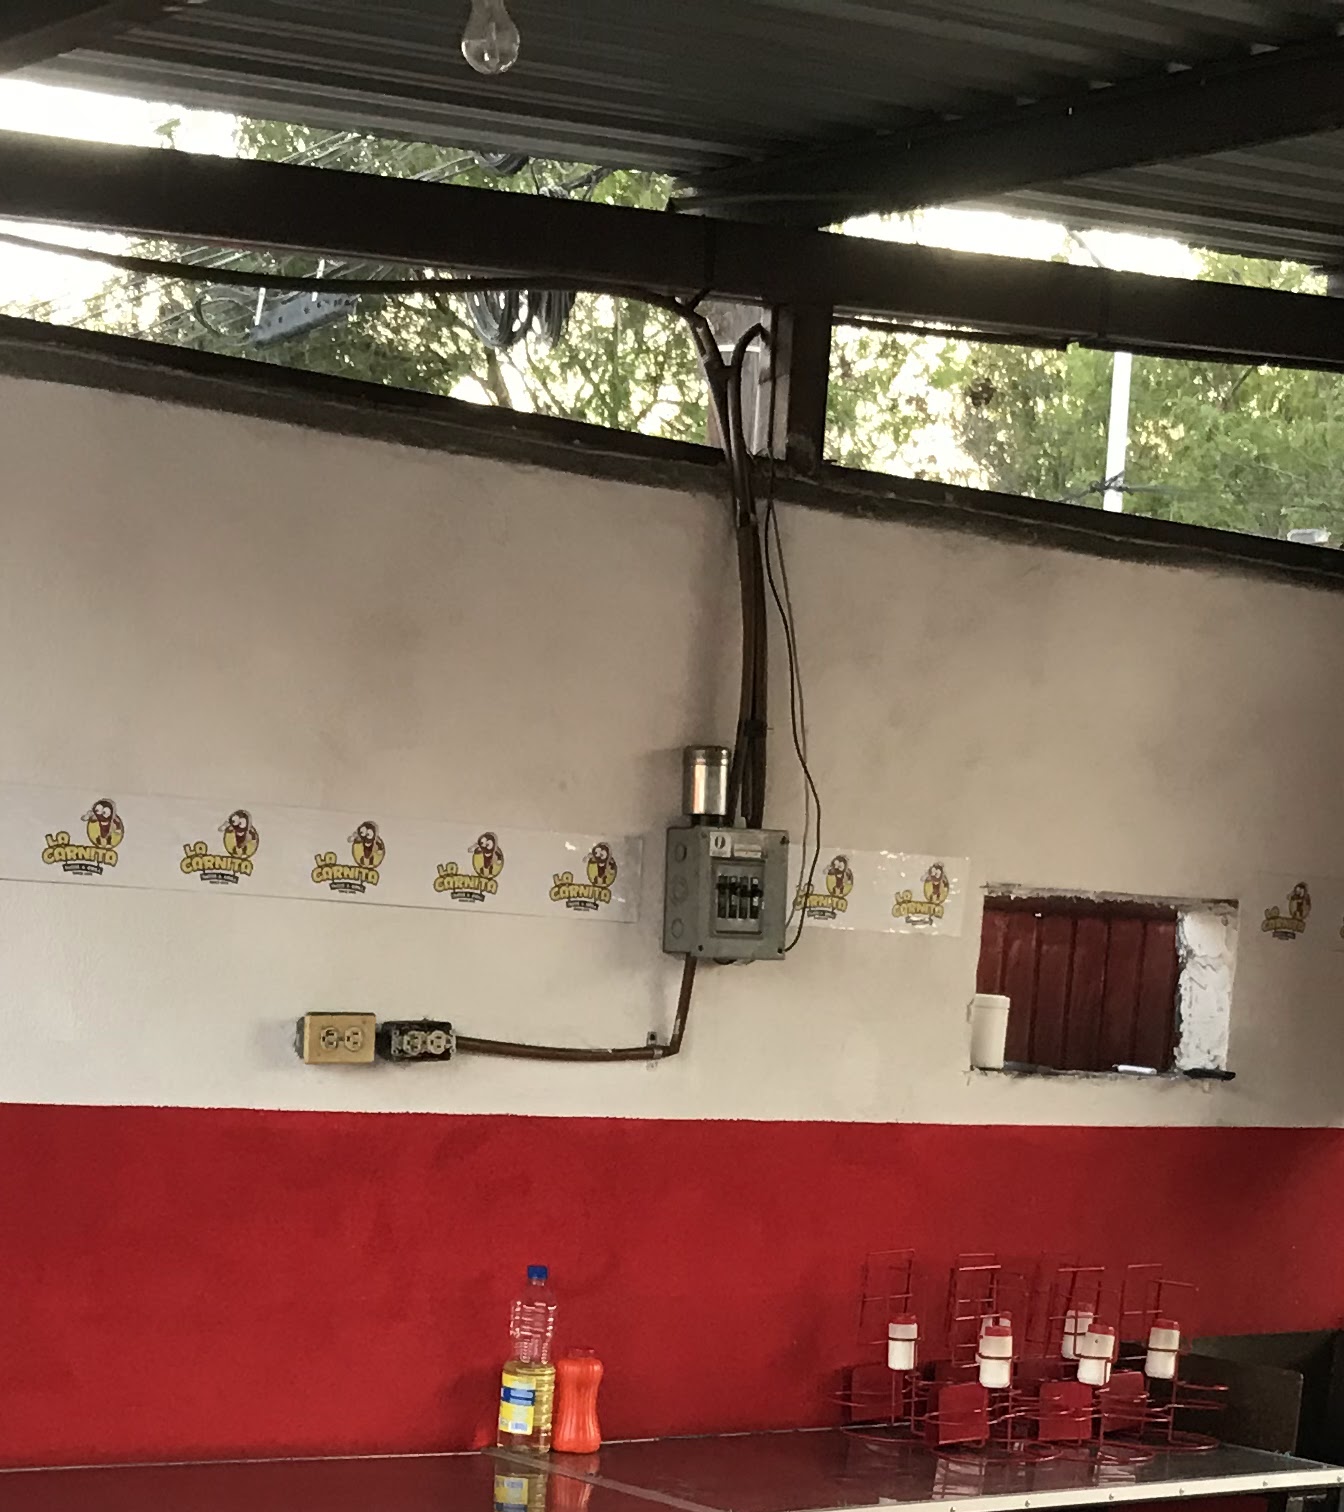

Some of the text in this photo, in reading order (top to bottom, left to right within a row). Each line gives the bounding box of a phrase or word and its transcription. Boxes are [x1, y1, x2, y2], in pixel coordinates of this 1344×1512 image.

[45, 830, 71, 847] LA
[41, 844, 118, 867] CARNITA
[183, 841, 208, 857] LA
[180, 854, 253, 876] CARNITA
[314, 851, 337, 867] LA
[311, 863, 380, 886] CARNITA
[437, 862, 459, 877] LA
[553, 871, 574, 886] LA
[433, 874, 498, 895] CARNITA
[549, 883, 612, 904] CARNITA
